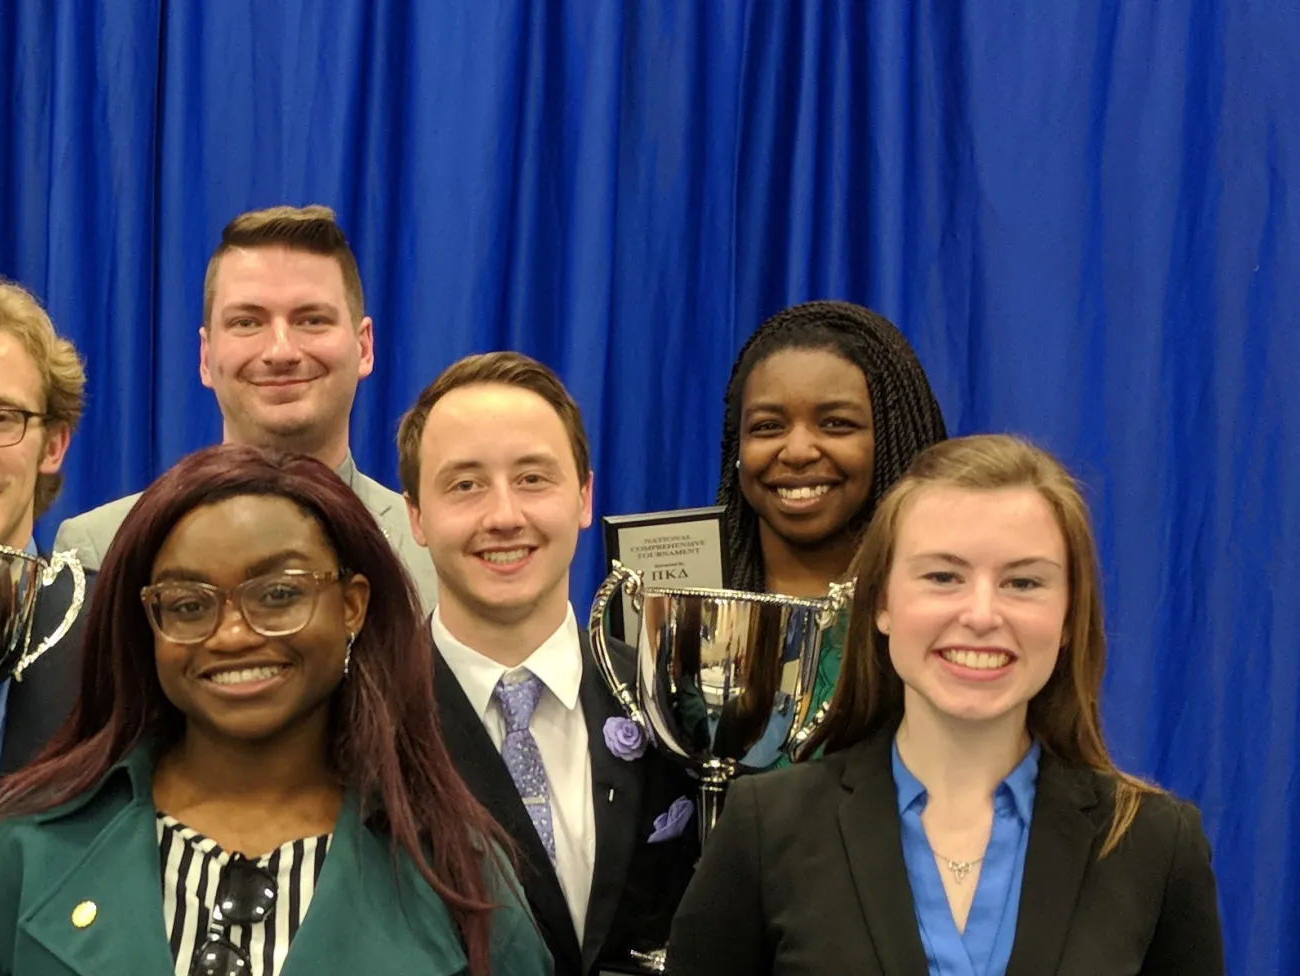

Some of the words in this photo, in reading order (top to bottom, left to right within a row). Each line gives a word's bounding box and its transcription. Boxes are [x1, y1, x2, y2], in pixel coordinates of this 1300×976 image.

[644, 534, 691, 544] NATIONAL
[630, 540, 706, 552] COMPREHENSIVE
[637, 548, 700, 559] TOURNAMENT
